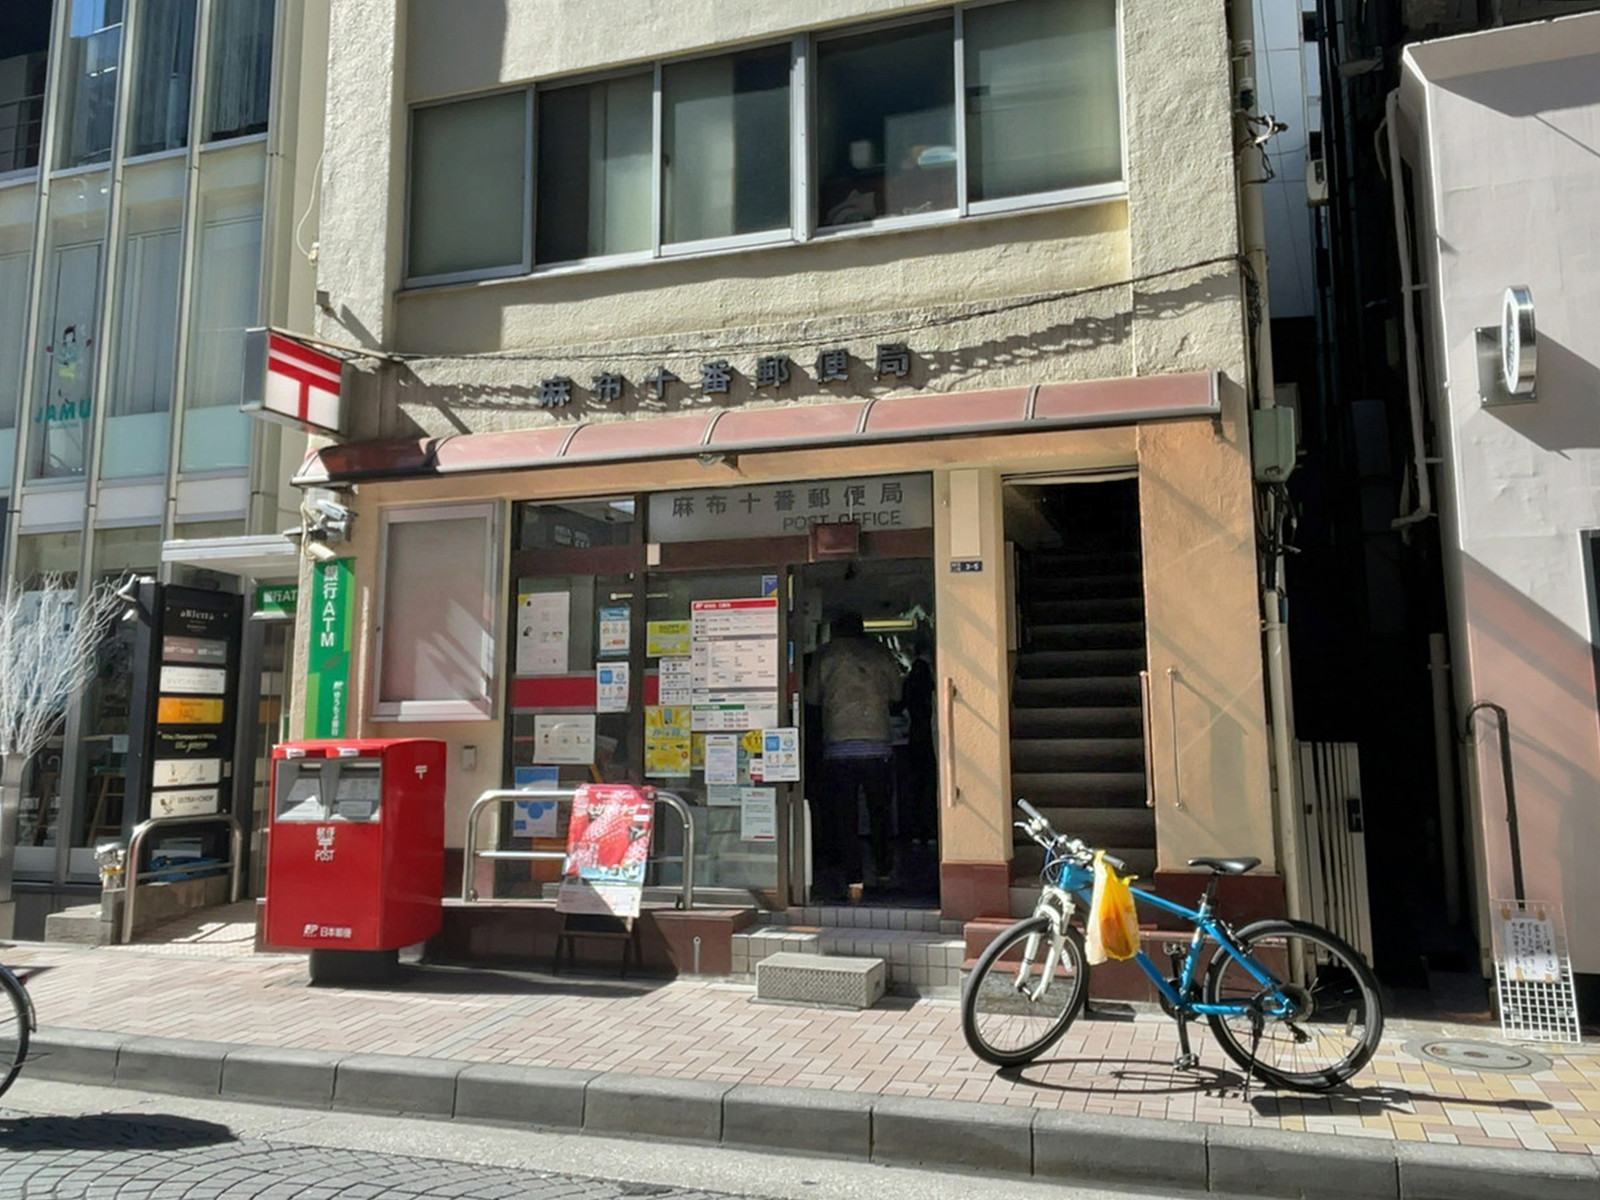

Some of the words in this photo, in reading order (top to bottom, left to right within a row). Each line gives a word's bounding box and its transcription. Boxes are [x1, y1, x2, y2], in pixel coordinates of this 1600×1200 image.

[539, 344, 909, 407] 麻布十番郵便局
[672, 482, 903, 518] 麻布十番郵便局
[320, 565, 339, 647] 銀行ATM
[315, 850, 335, 861] POST
